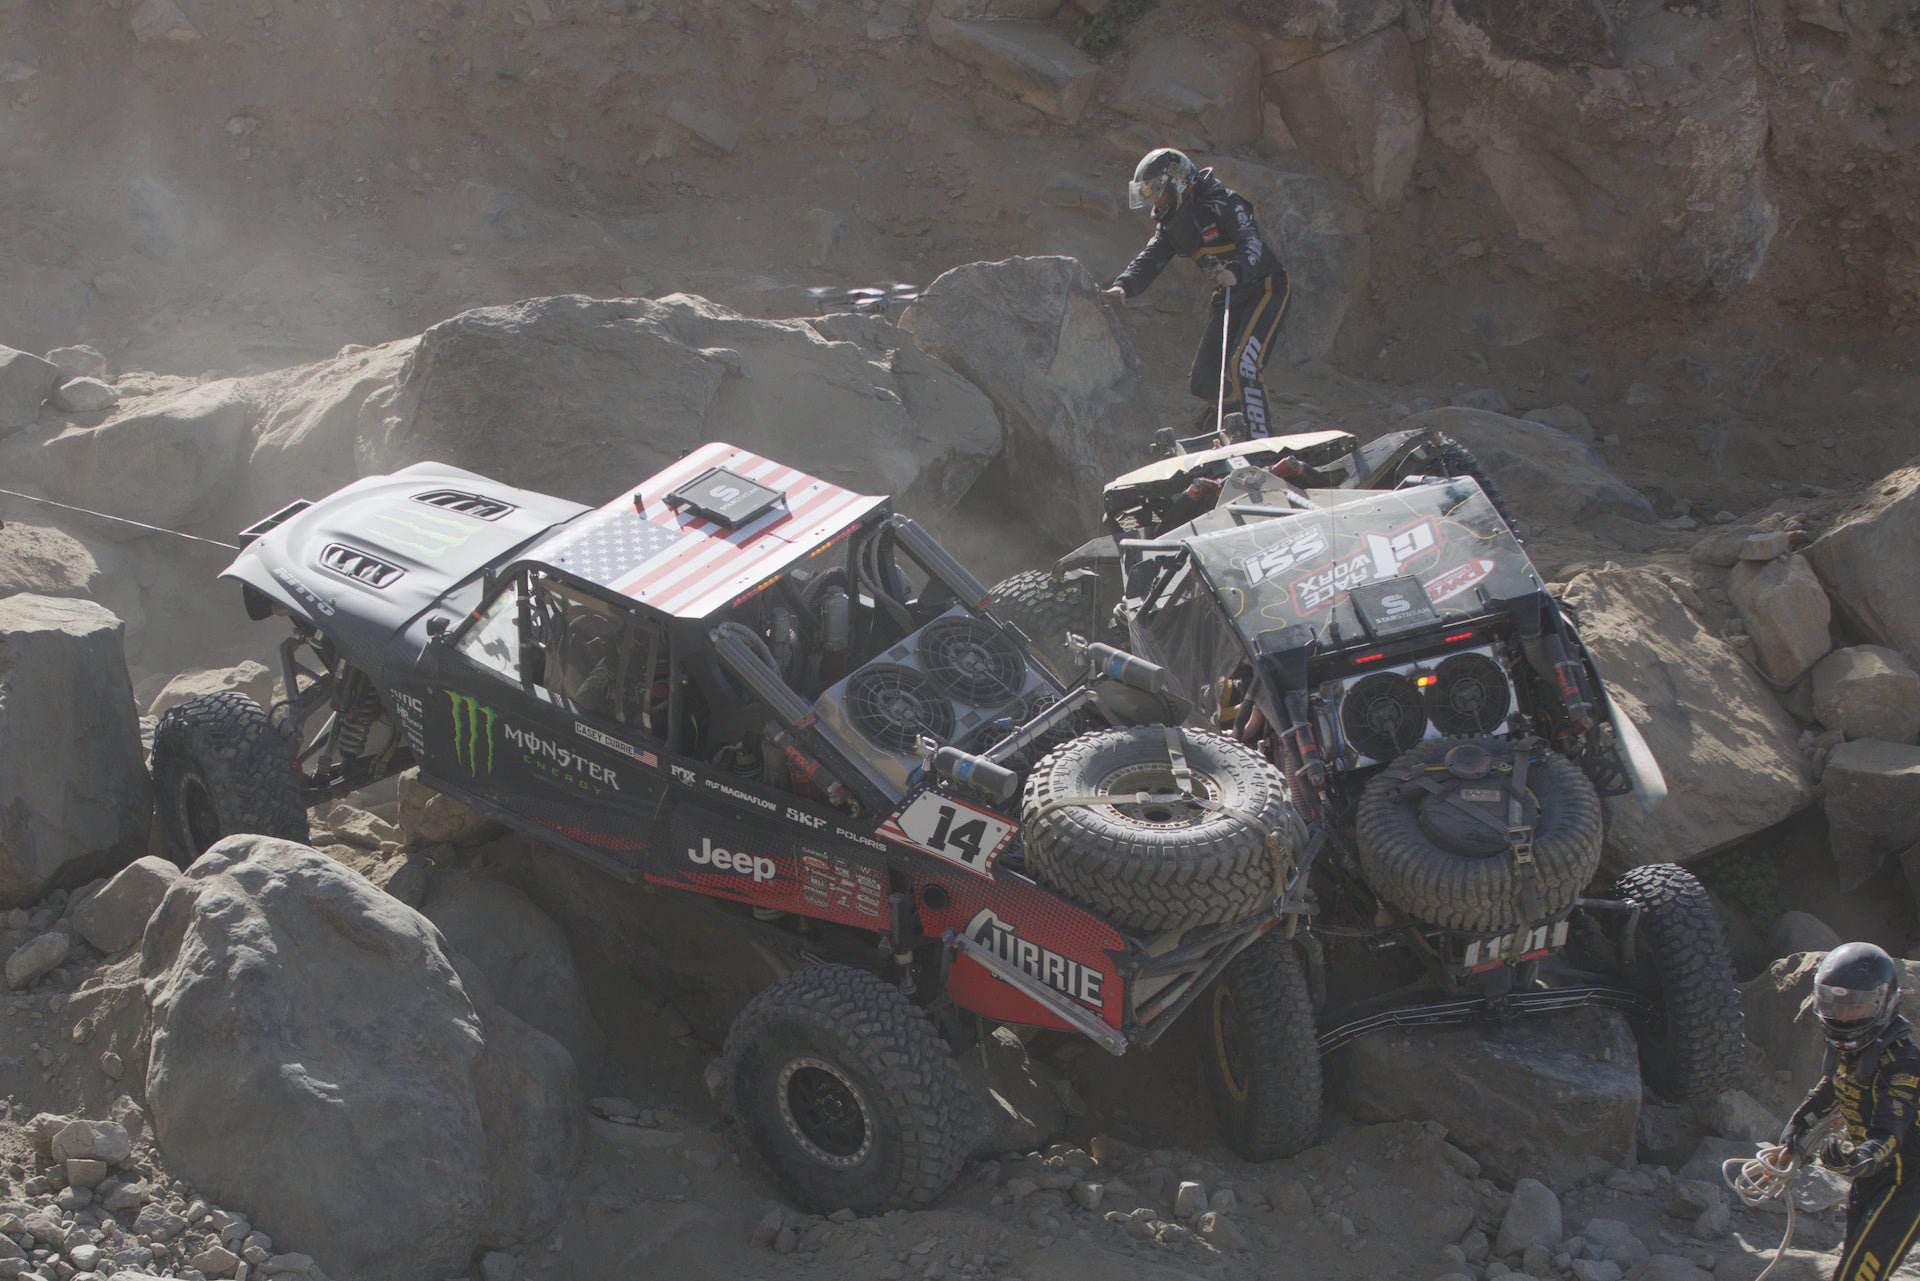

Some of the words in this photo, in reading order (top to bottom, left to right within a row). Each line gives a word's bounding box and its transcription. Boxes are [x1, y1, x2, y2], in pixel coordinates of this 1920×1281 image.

[1296, 553, 1371, 597] WORX
[1306, 566, 1367, 609] RACE
[1375, 606, 1431, 624] STARSTREAM
[504, 723, 621, 791] MONSTER
[575, 723, 603, 745] CASEY
[604, 733, 635, 756] CURRIE
[523, 754, 602, 796] ENERGY
[671, 763, 696, 786] FOX
[720, 783, 777, 812] MAGNAFLOW
[785, 807, 827, 829] SKF
[836, 826, 887, 852] POLARIS
[926, 805, 989, 863] 14
[688, 837, 776, 882] Jeep
[964, 907, 1105, 1008] CURRIE
